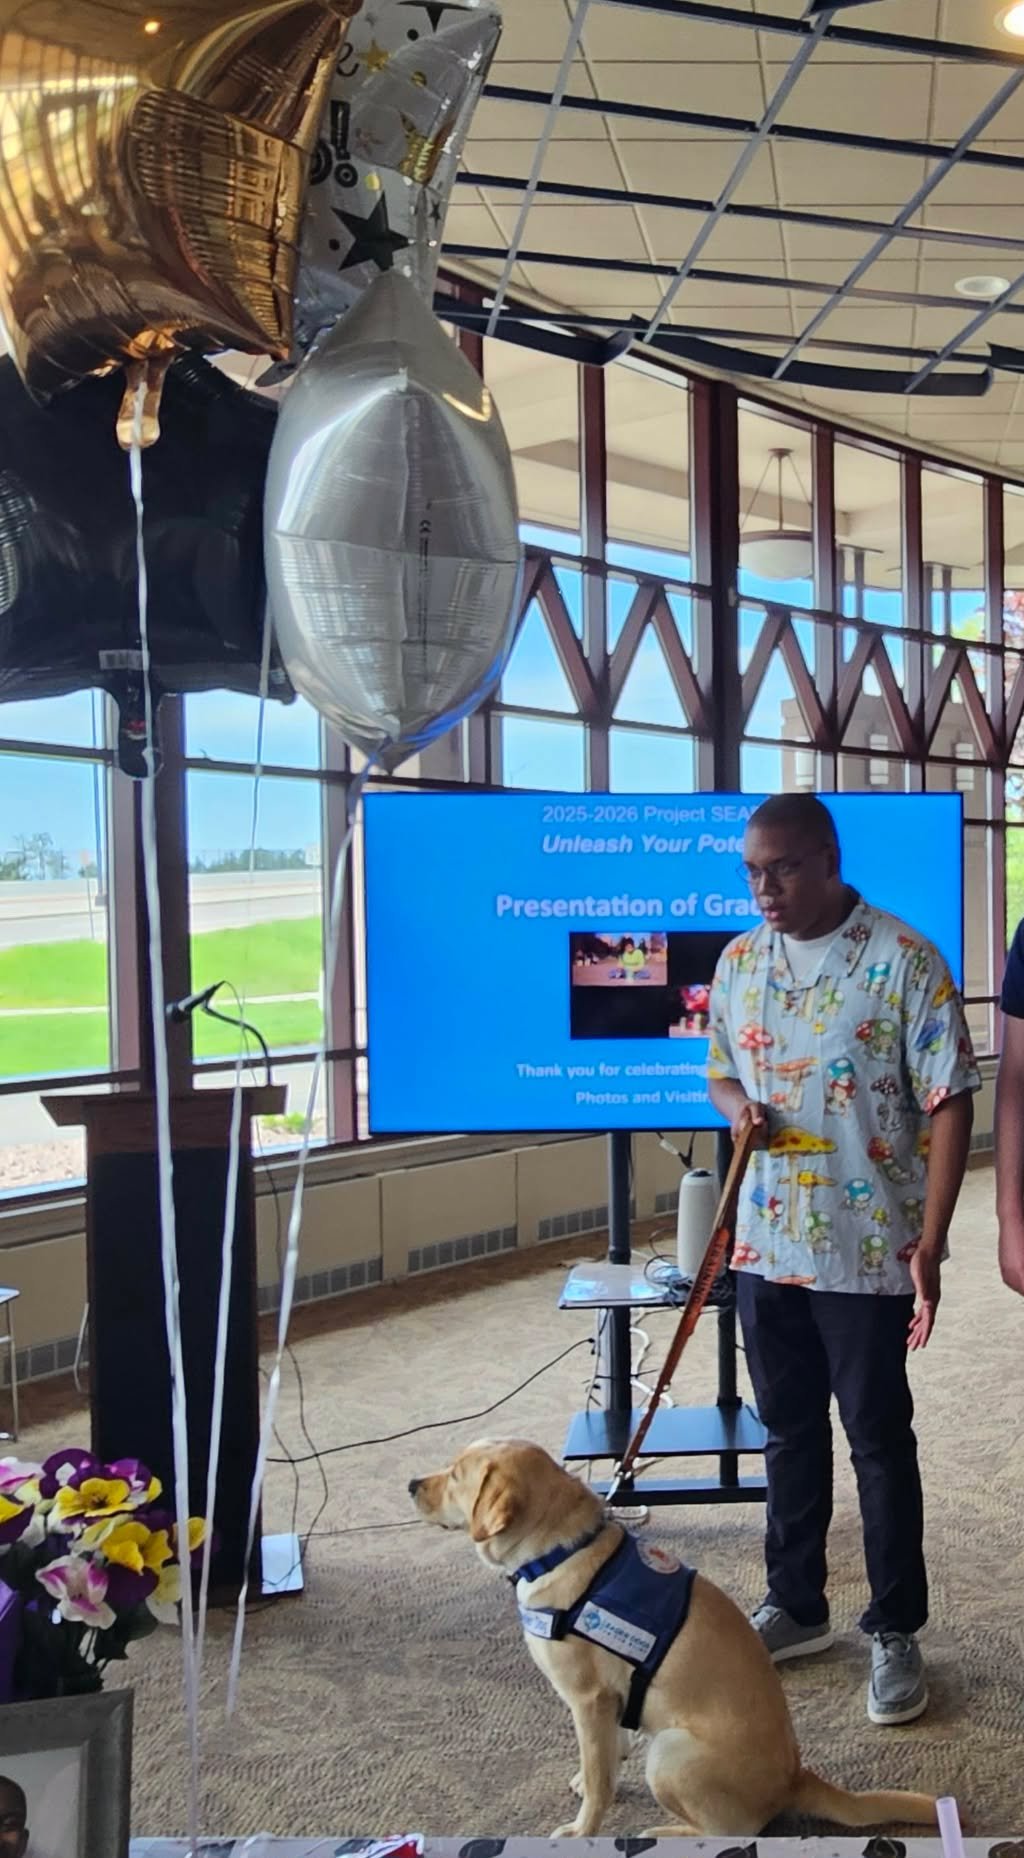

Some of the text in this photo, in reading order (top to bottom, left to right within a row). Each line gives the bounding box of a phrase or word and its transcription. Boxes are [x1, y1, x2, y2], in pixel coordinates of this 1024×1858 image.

[542, 805, 638, 823] 2025-2026
[643, 805, 706, 826] Project
[542, 833, 633, 853] Unleash
[641, 834, 691, 853] Your
[497, 893, 663, 918] Presentation
[670, 893, 697, 917] of
[516, 1063, 562, 1078] Thank
[567, 1065, 594, 1080] you
[599, 1063, 621, 1077] for
[576, 1091, 628, 1105] Photos
[633, 1091, 661, 1104] and
